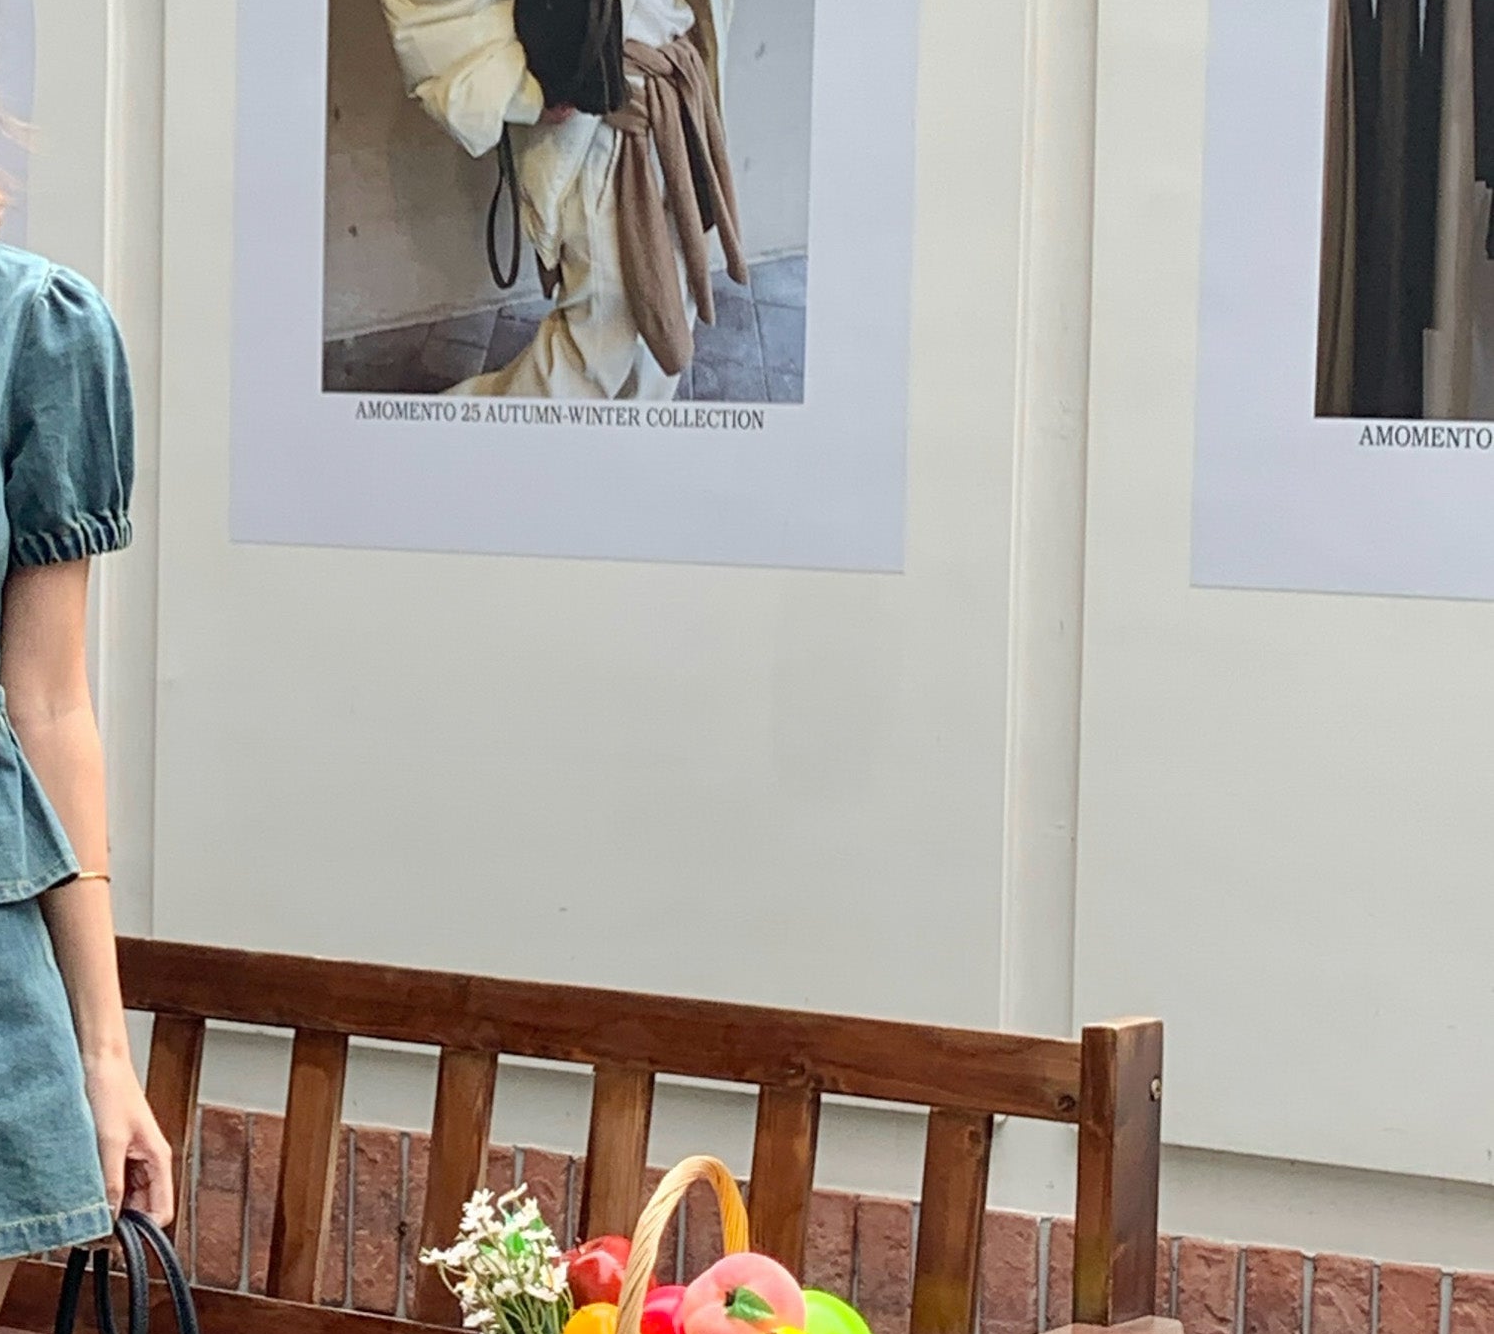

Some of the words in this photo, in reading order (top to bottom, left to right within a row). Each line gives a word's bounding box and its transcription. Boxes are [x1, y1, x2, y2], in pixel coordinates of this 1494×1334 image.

[355, 399, 457, 422] AMOMENTO
[460, 401, 482, 423] 25
[484, 402, 642, 428] AUTUMN-WINTER
[645, 406, 766, 430] COLLECTION
[1358, 424, 1494, 450] AMOMENTO
